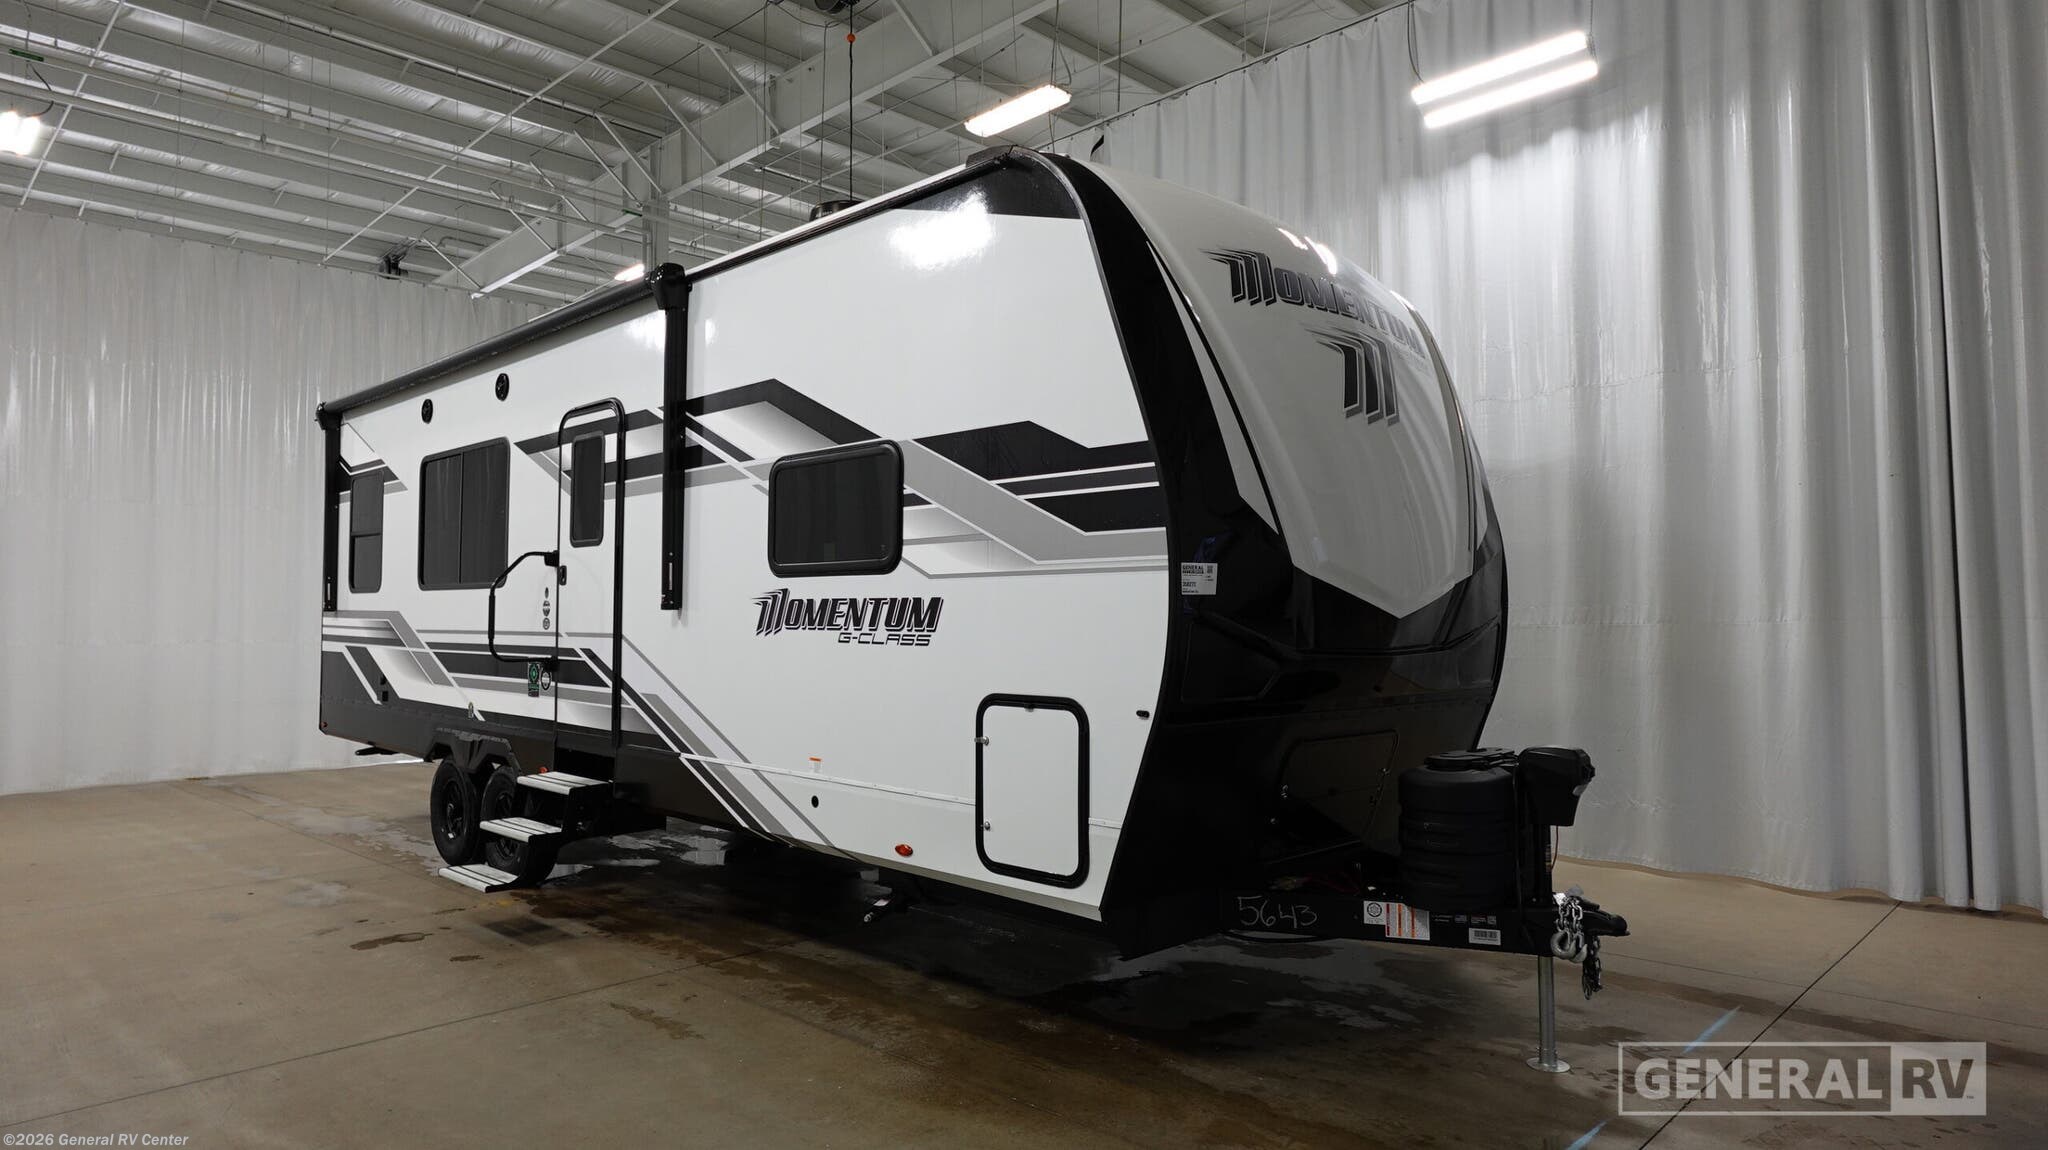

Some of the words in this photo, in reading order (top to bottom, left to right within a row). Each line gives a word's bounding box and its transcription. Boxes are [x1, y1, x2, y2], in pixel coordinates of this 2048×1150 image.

[1202, 247, 1426, 358] MOMENTUM
[752, 588, 944, 636] MOMENTUM
[838, 632, 932, 646] G-CLASS
[1237, 895, 1318, 928] 5643
